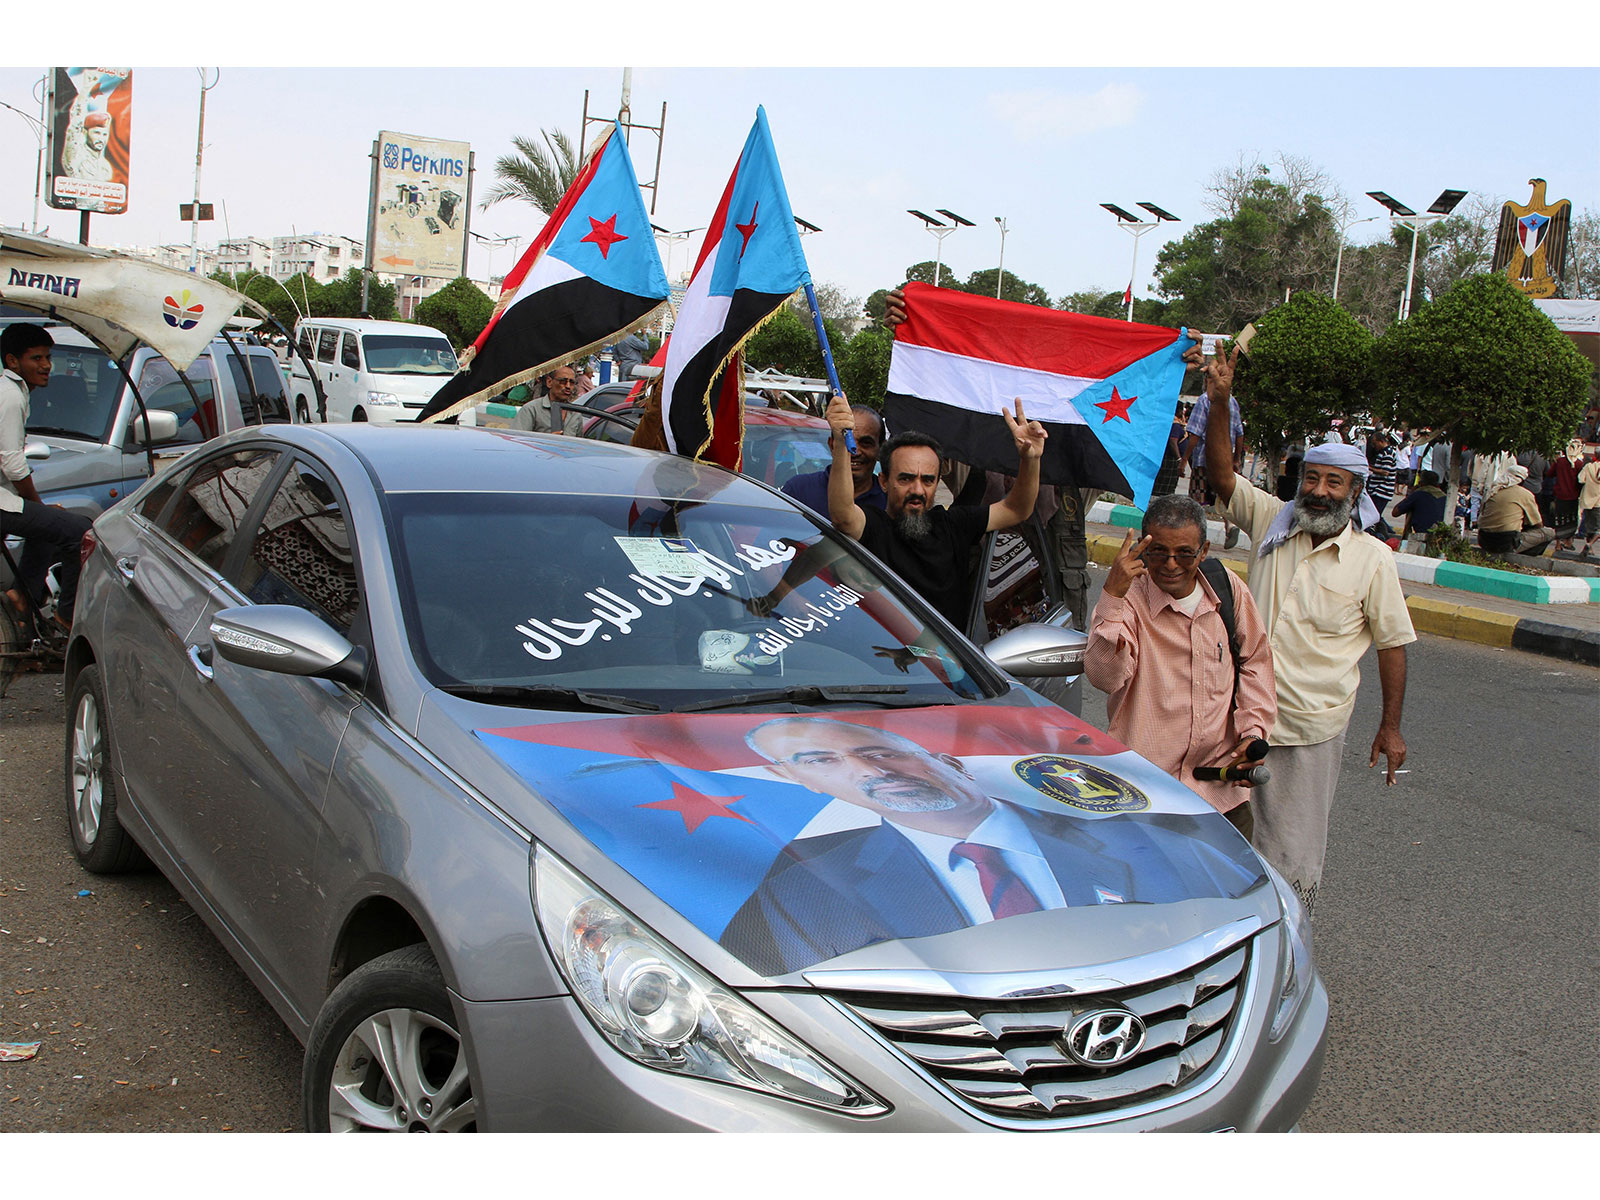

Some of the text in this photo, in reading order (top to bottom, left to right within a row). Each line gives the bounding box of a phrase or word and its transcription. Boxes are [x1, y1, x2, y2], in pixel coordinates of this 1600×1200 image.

[401, 147, 464, 177] Perkins
[8, 267, 81, 298] NANA
[628, 549, 744, 606] الرجال
[515, 586, 642, 661] للرجال
[778, 612, 829, 638] رجال
[756, 627, 794, 656] الله
